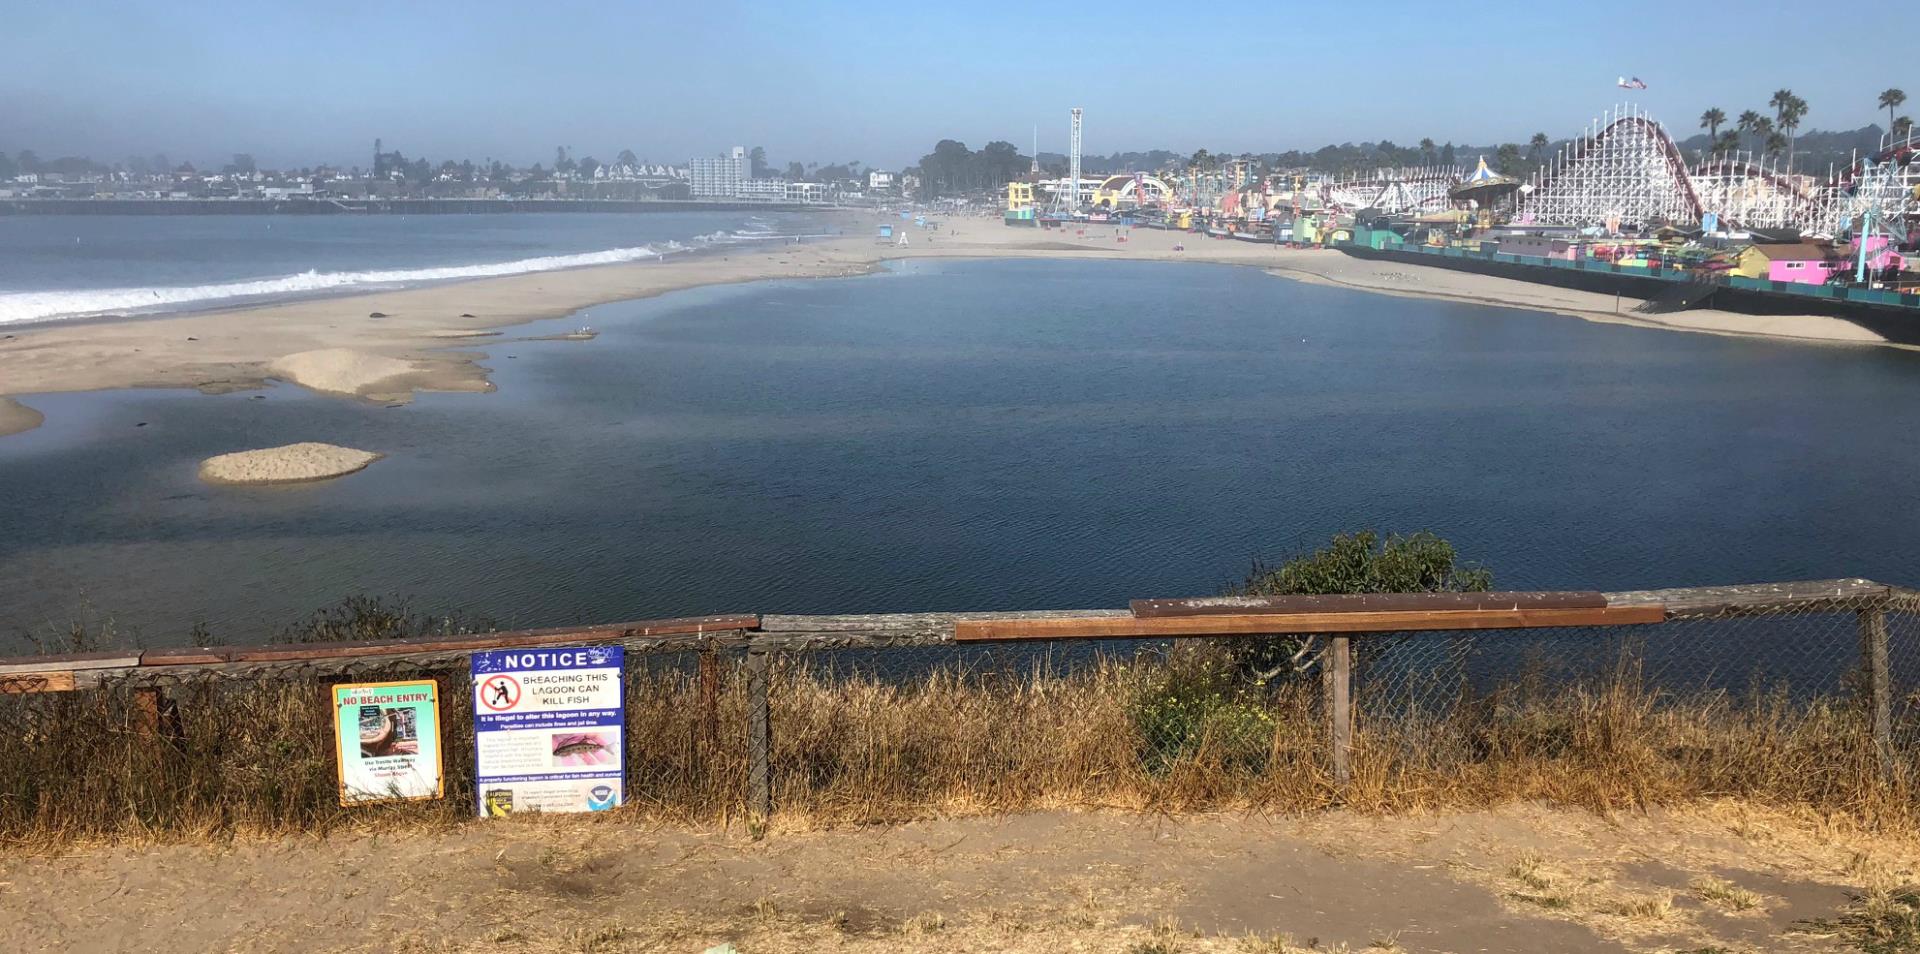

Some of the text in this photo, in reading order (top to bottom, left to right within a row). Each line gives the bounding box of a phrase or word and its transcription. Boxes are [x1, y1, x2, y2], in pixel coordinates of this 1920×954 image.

[505, 652, 587, 668] NOTICE
[523, 673, 608, 684] BREACHING THIS
[532, 685, 600, 695] LAGOON CAN
[343, 693, 428, 705] NO BEACH ENTRY
[542, 696, 590, 705] KILL FISH
[495, 714, 515, 722] illegal
